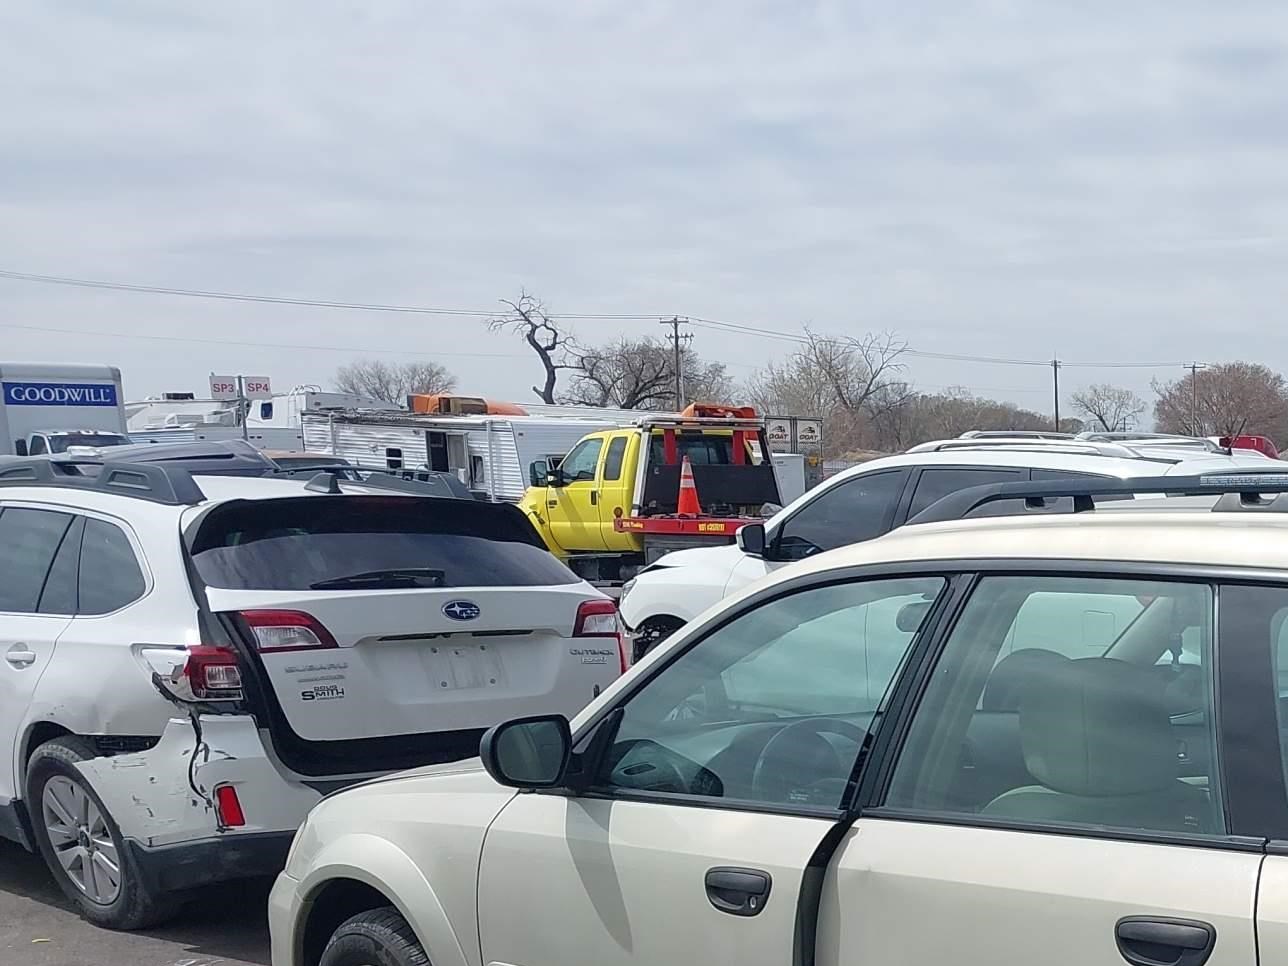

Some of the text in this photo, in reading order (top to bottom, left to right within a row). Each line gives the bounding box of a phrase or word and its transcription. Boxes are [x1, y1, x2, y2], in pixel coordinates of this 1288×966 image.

[212, 383, 235, 393] SP3
[247, 383, 269, 393] SP4
[10, 386, 110, 403] GOODWILL
[301, 687, 345, 701] SMITH
